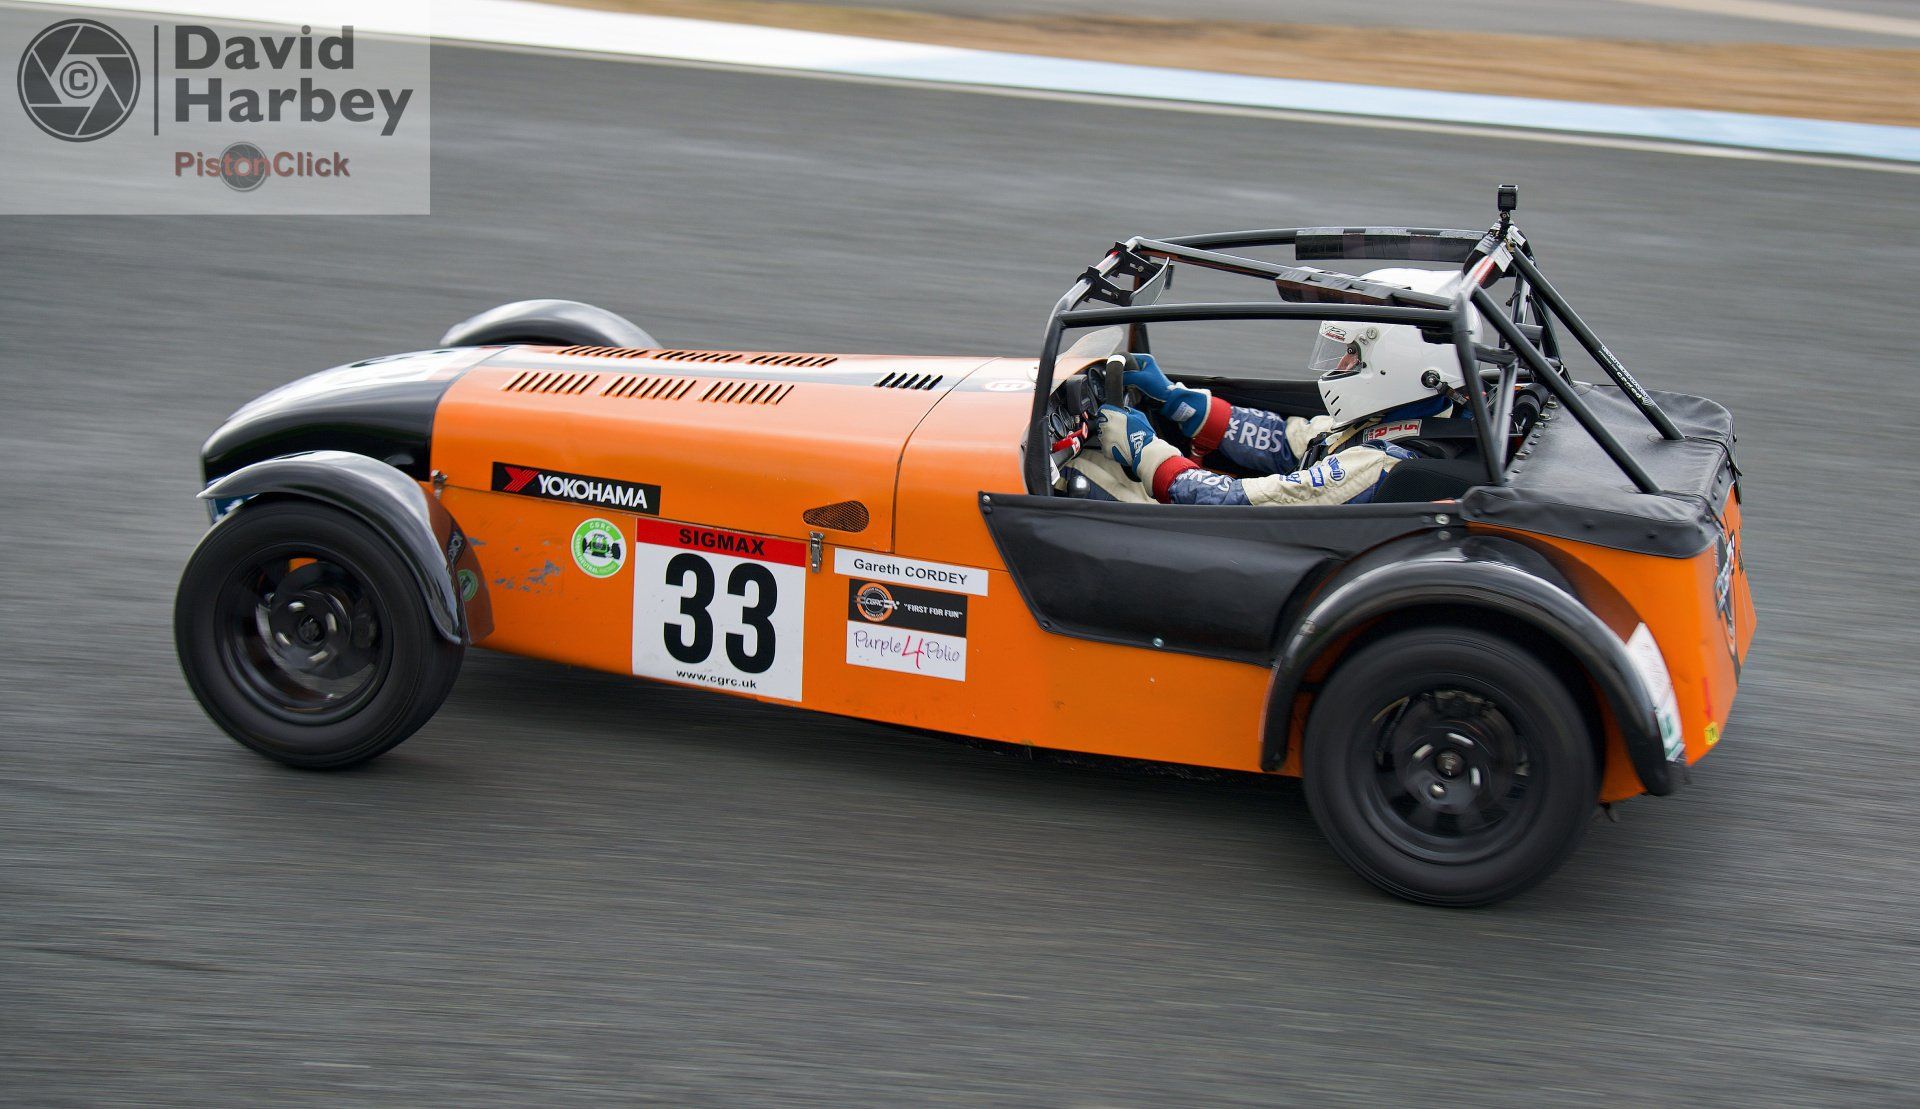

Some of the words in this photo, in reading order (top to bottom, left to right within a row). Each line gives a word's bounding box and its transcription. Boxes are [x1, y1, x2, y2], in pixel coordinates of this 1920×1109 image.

[1238, 421, 1283, 453] RBS
[537, 474, 648, 509] YOKOHAMA
[679, 528, 765, 556] SIGMAX
[854, 558, 900, 576] Gareth
[905, 566, 968, 586] CORDEY
[664, 553, 778, 674] 33
[929, 607, 943, 616] FOR
[676, 669, 757, 689] www.cgrc.uk
